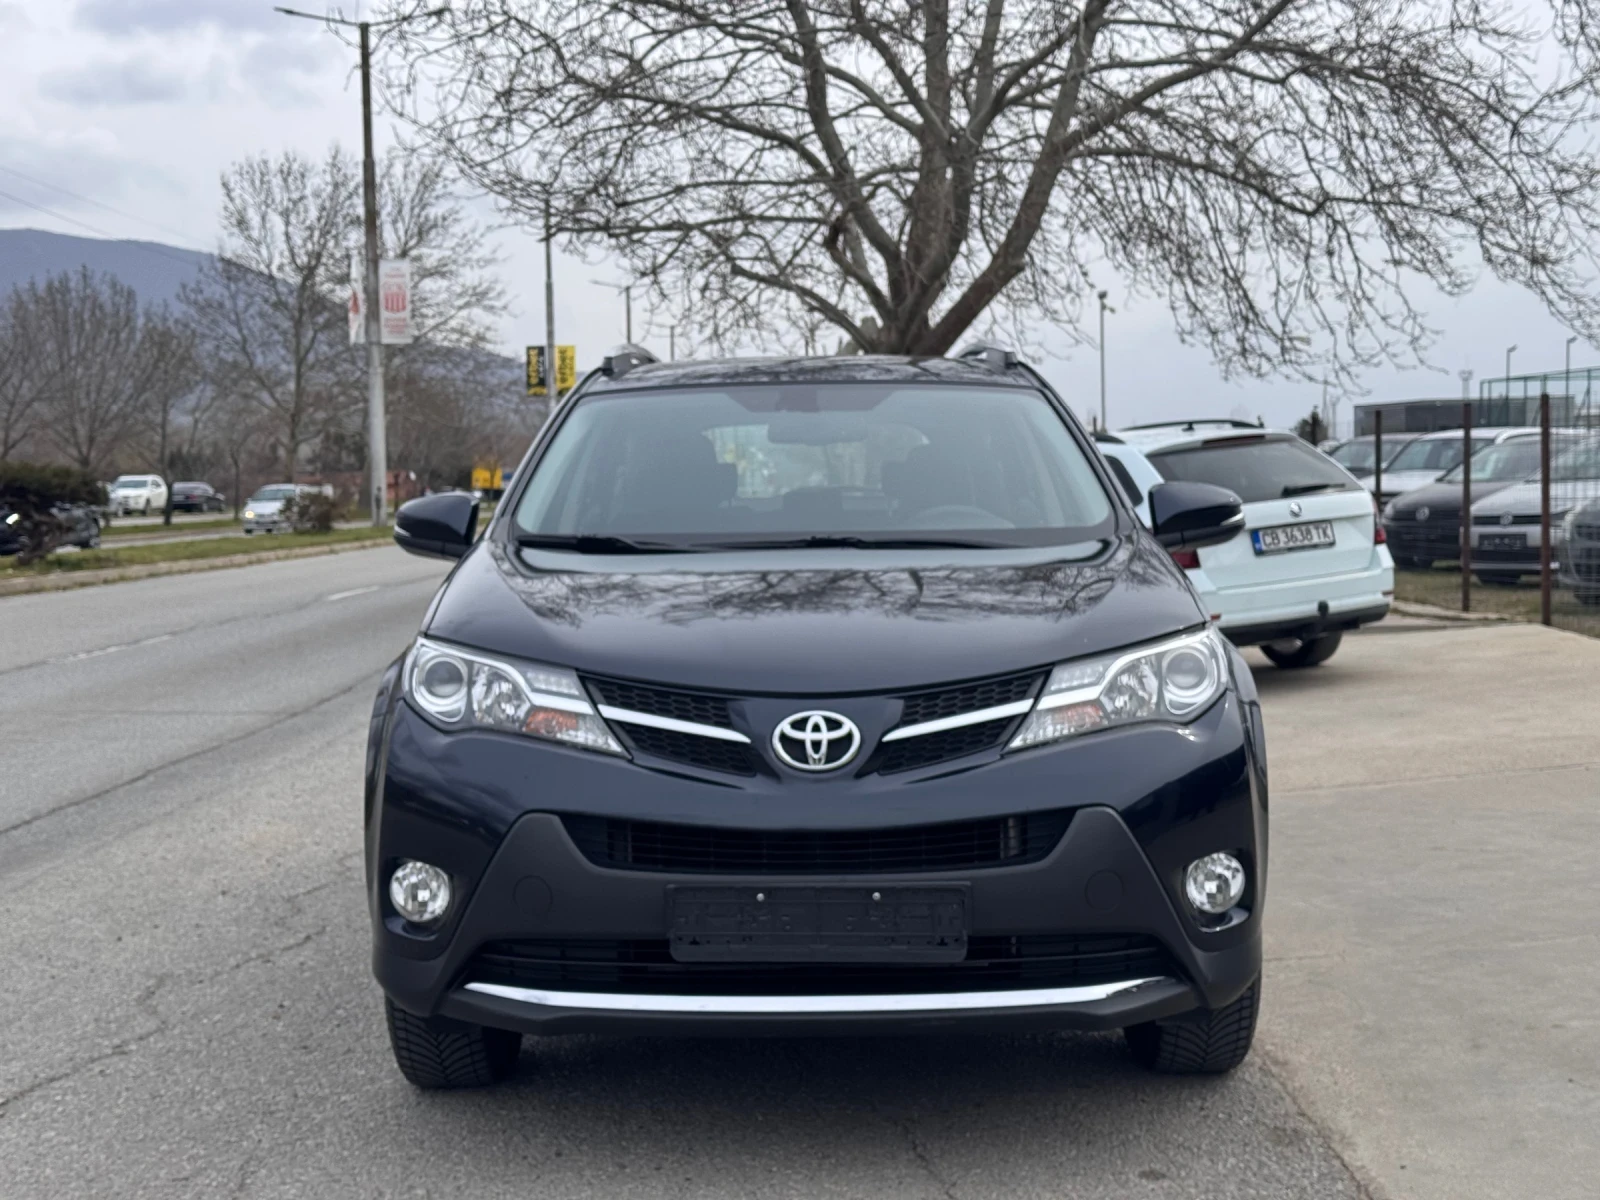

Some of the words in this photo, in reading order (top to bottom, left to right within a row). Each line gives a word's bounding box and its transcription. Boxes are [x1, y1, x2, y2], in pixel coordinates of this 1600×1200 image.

[1262, 531, 1280, 547] CB
[1281, 526, 1313, 545] 3638
[1314, 523, 1331, 541] TK
